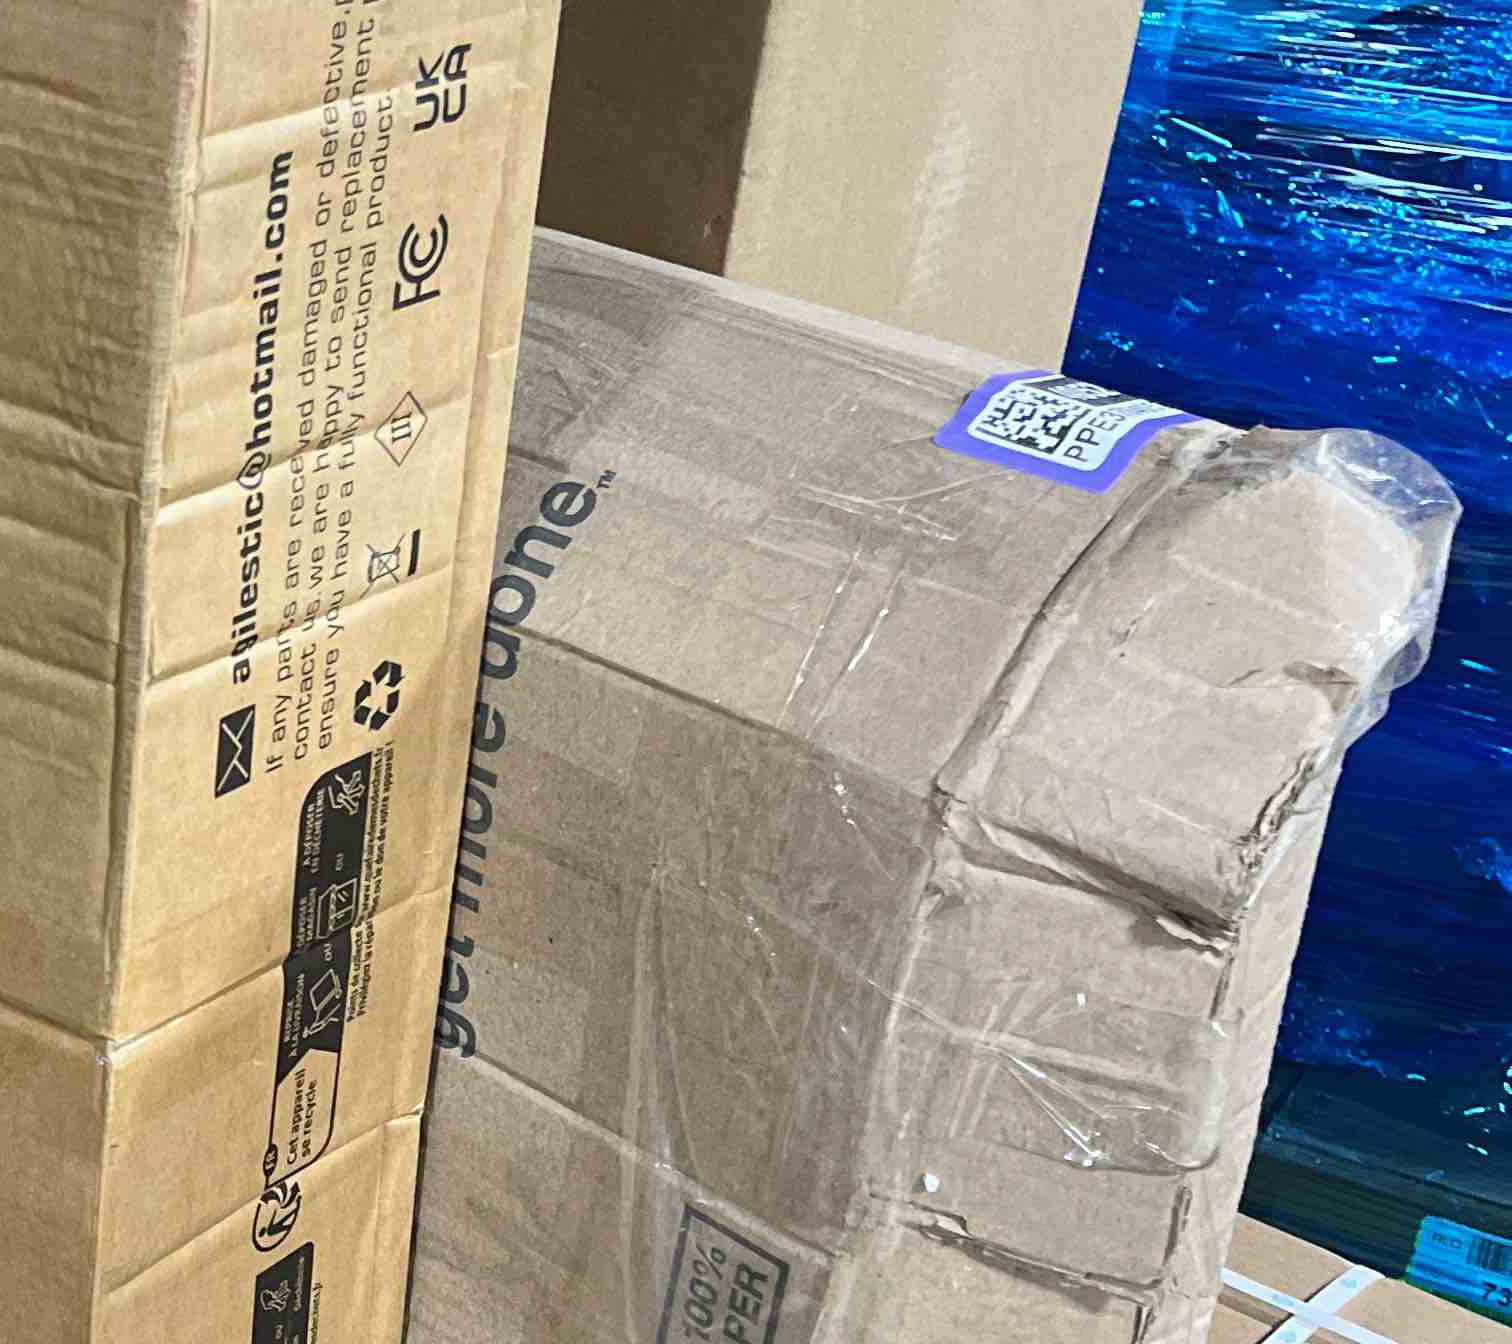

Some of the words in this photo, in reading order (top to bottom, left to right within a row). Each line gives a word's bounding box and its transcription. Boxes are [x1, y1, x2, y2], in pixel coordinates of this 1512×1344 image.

[340, 17, 375, 234] replacement
[315, 191, 332, 227] or
[297, 239, 328, 387] damaged
[330, 246, 353, 324] send
[347, 241, 377, 401] functional
[325, 335, 343, 372] to
[231, 150, 294, 685] agilestic@hotmail.com
[312, 384, 344, 473] happy
[338, 413, 365, 470] fully
[289, 399, 314, 528] received
[340, 479, 354, 498] a
[313, 483, 330, 534] are
[330, 509, 352, 582] have
[285, 538, 302, 589] are
[277, 599, 297, 683] parts
[326, 589, 345, 639] you
[272, 693, 293, 744] any
[294, 642, 316, 760] contact
[318, 647, 340, 749] ensure
[266, 754, 284, 774] If
[687, 1244, 729, 1342] 100%
